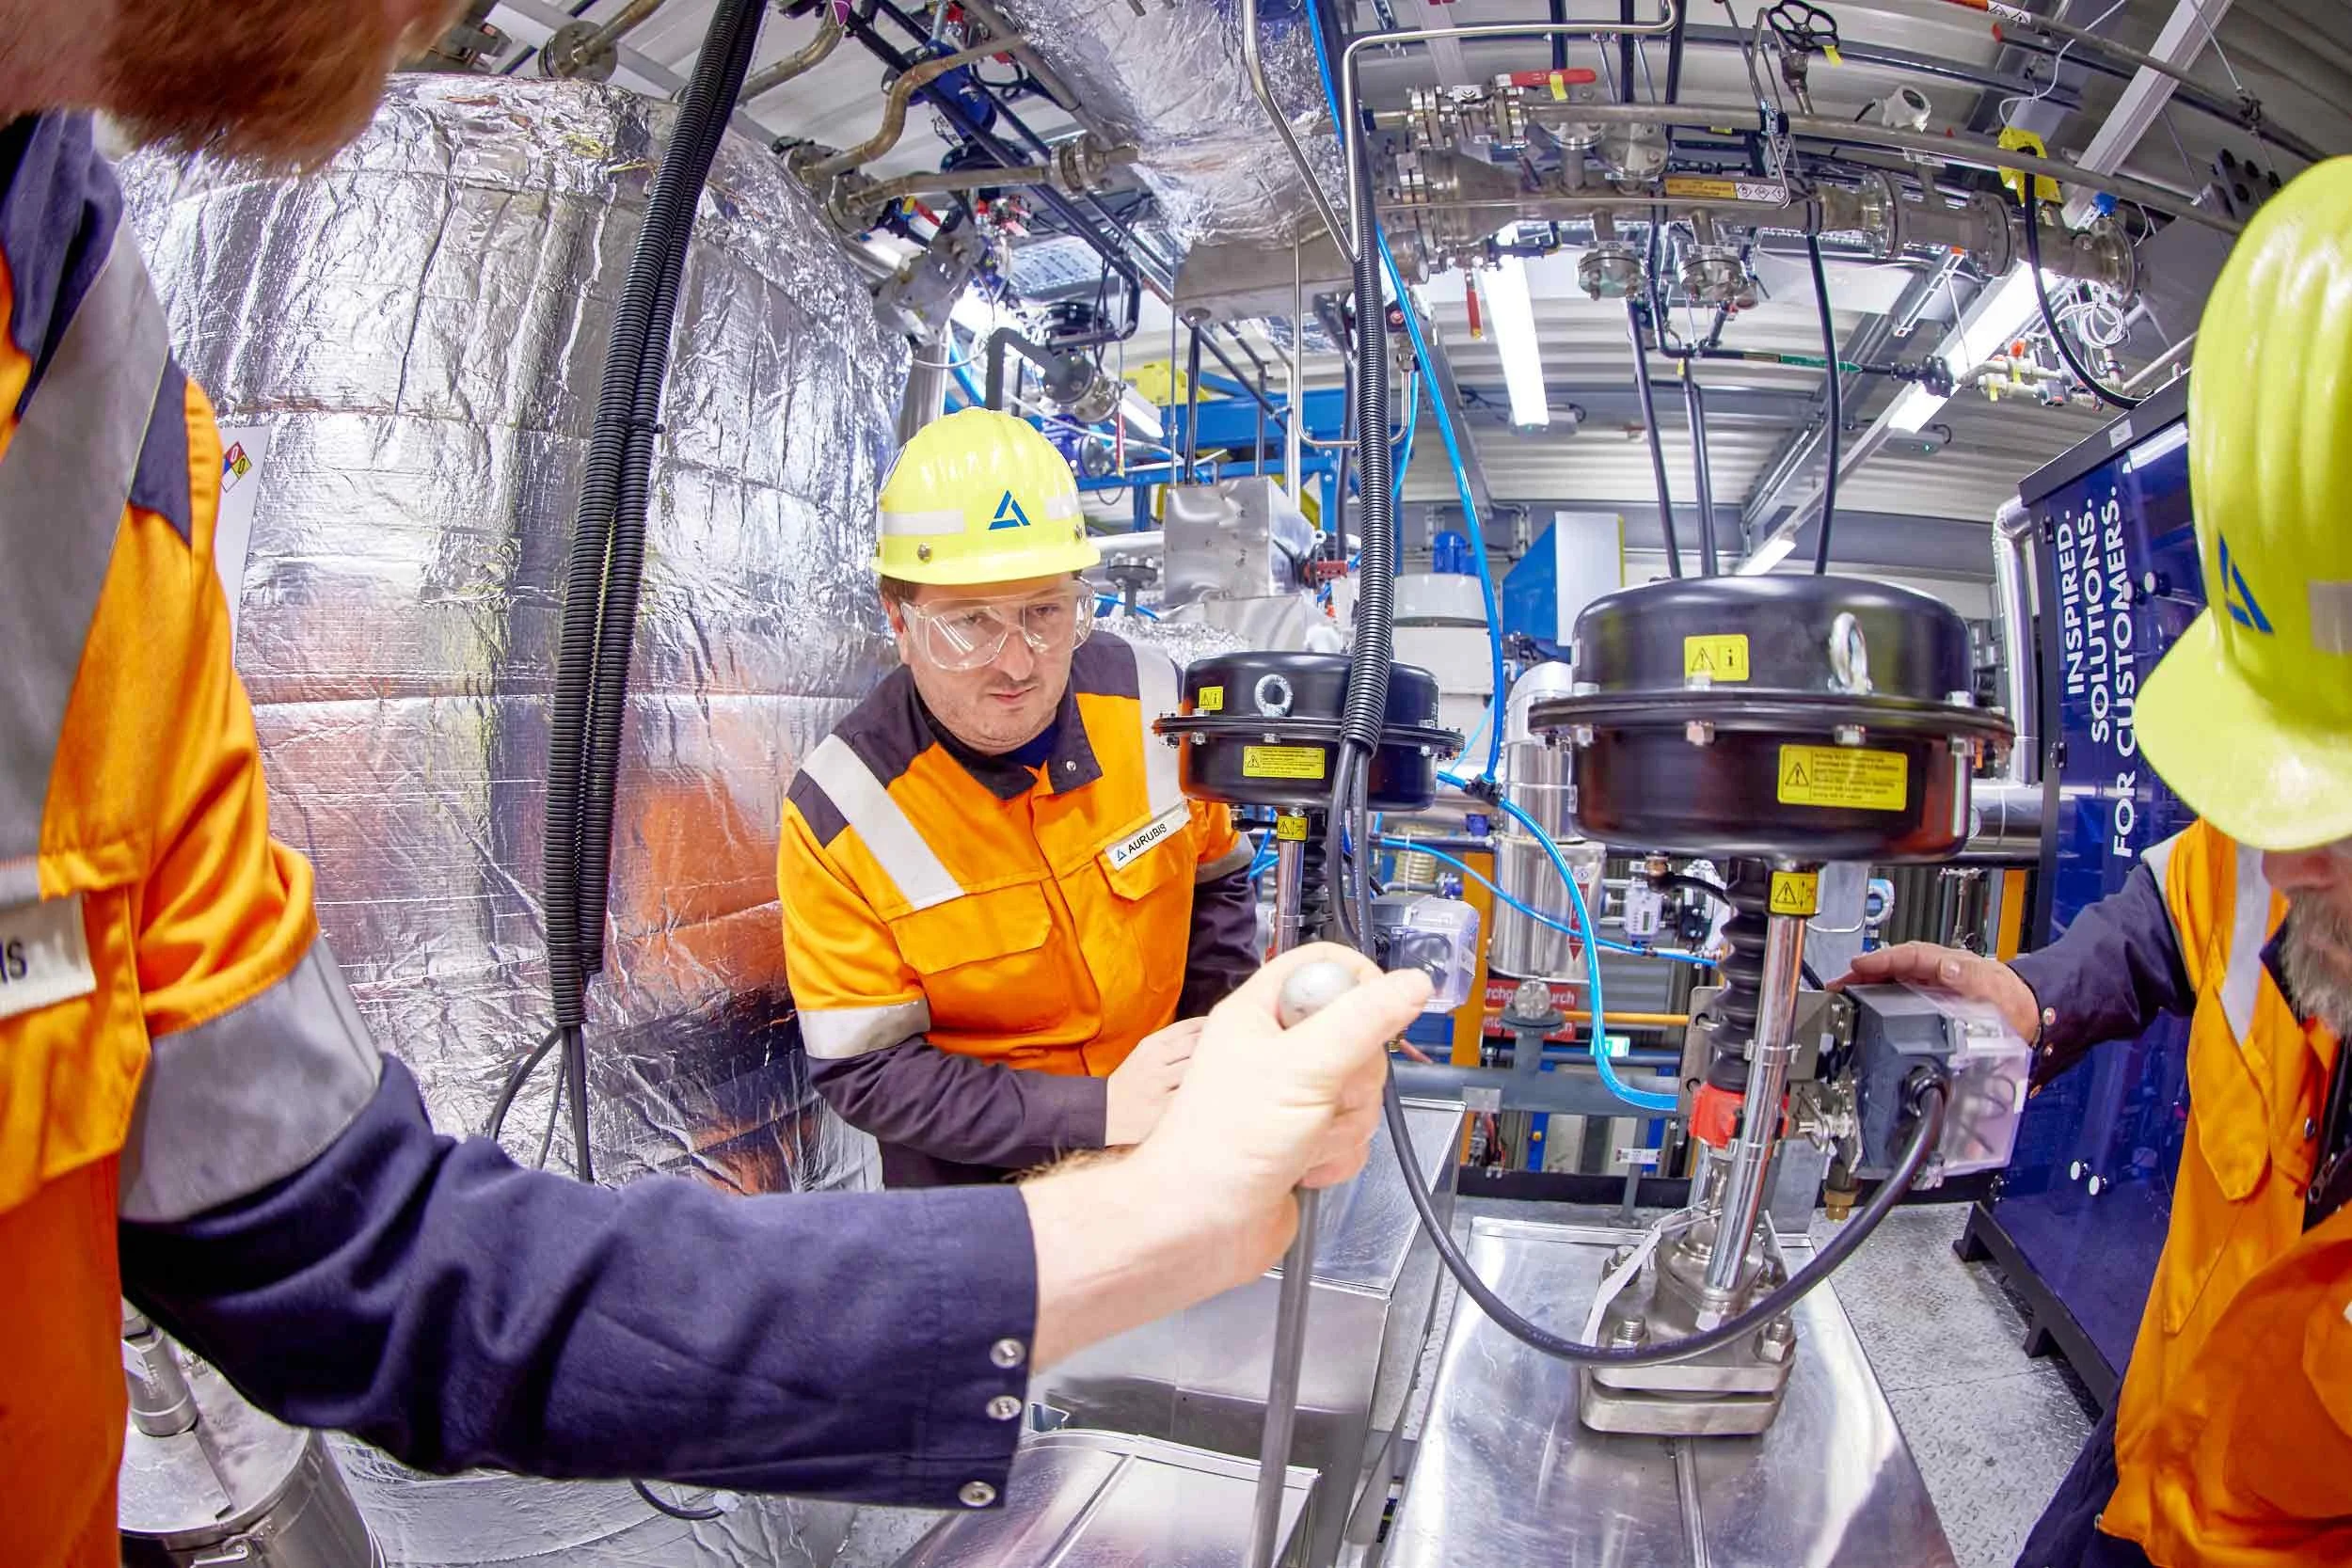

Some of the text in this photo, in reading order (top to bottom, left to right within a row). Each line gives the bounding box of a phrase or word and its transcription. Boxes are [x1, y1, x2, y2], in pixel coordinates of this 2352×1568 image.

[2057, 510, 2085, 694] INSPIRED.
[2077, 498, 2109, 744] SOLUTIONS.
[2101, 485, 2137, 858] FOR CUSTOMERS.
[1127, 823, 1168, 854] AURUBIS
